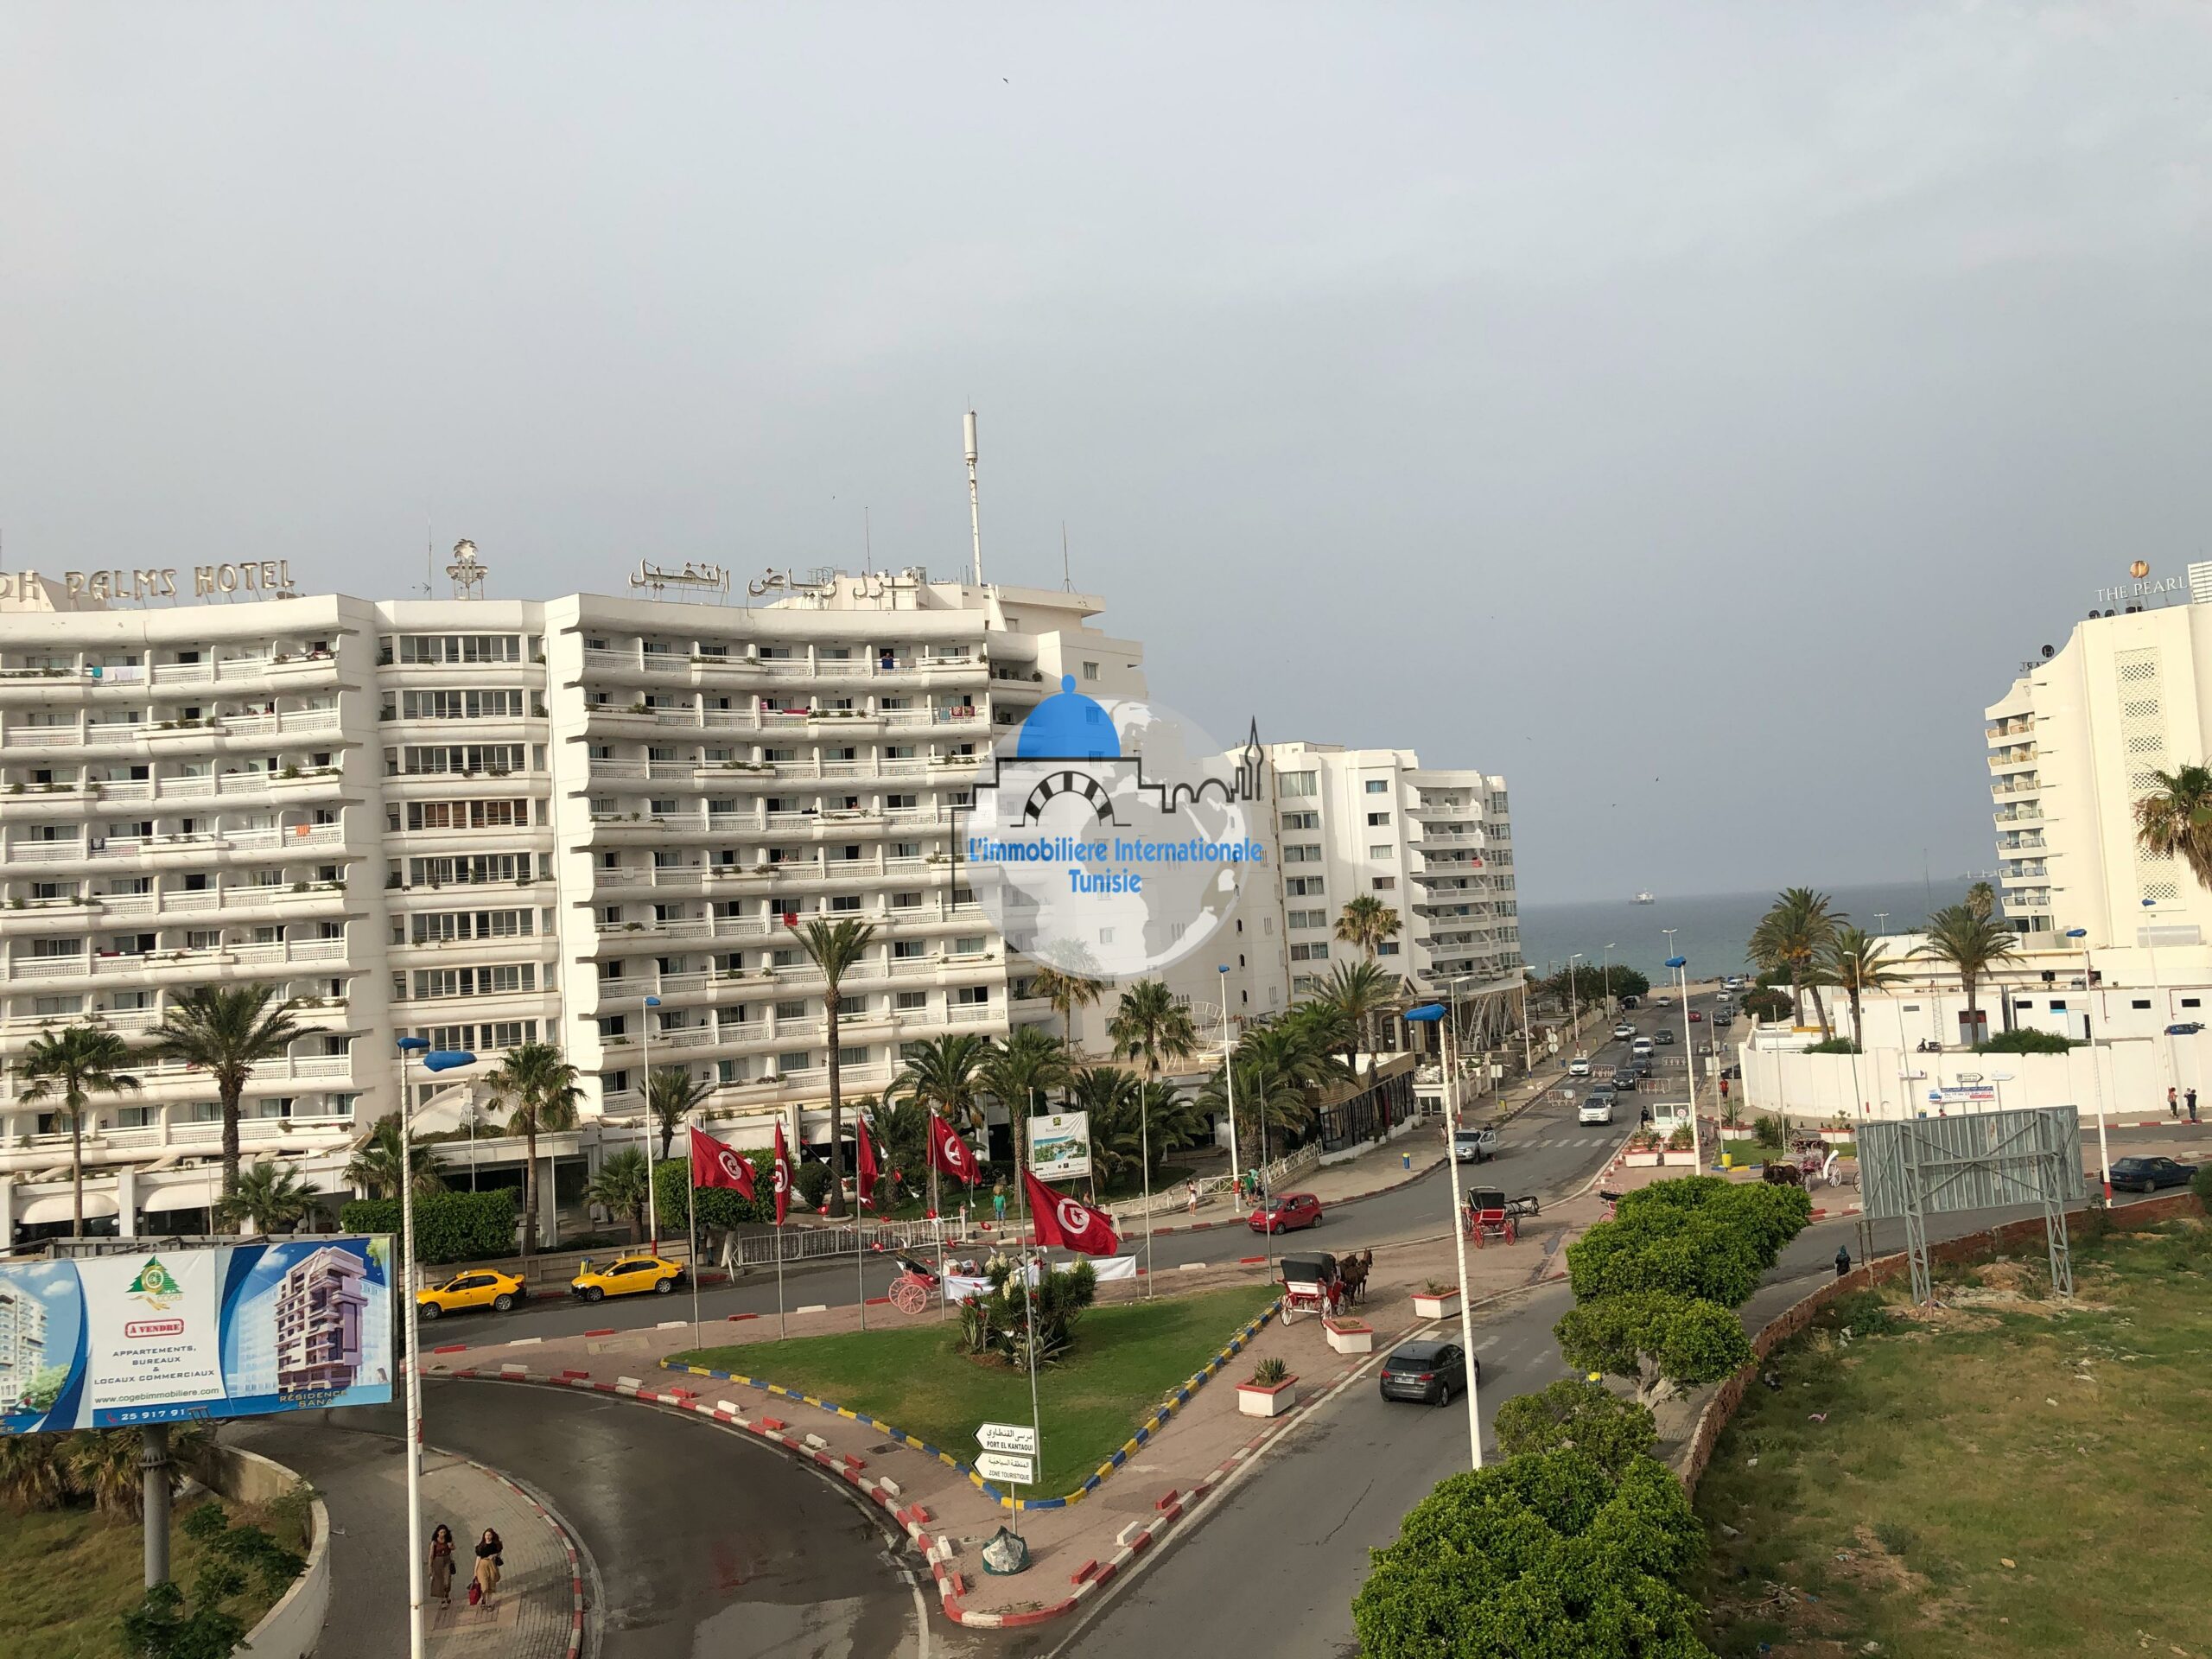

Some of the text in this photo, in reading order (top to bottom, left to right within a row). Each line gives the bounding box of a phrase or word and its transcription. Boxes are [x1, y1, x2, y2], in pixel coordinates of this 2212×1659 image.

[65, 569, 177, 601] PALMS
[194, 560, 296, 597] HOTEL
[628, 558, 729, 594] النخيل
[747, 567, 836, 600] رياض
[2094, 576, 2188, 602] THE PEARL
[139, 1324, 180, 1333] VENDRE
[112, 1345, 197, 1357] APPARTEMENTS,
[132, 1357, 181, 1366] BUREAUX
[94, 1370, 214, 1385] LOCAUX COMMERCIAUX
[95, 1388, 219, 1403] www.cogebimmobiliere.com
[298, 1398, 333, 1408] SANA
[121, 1408, 192, 1421] 25 917 91
[986, 1428, 1014, 1439] القنطاوي
[1002, 1471, 1030, 1480] TOURISTIQUE
